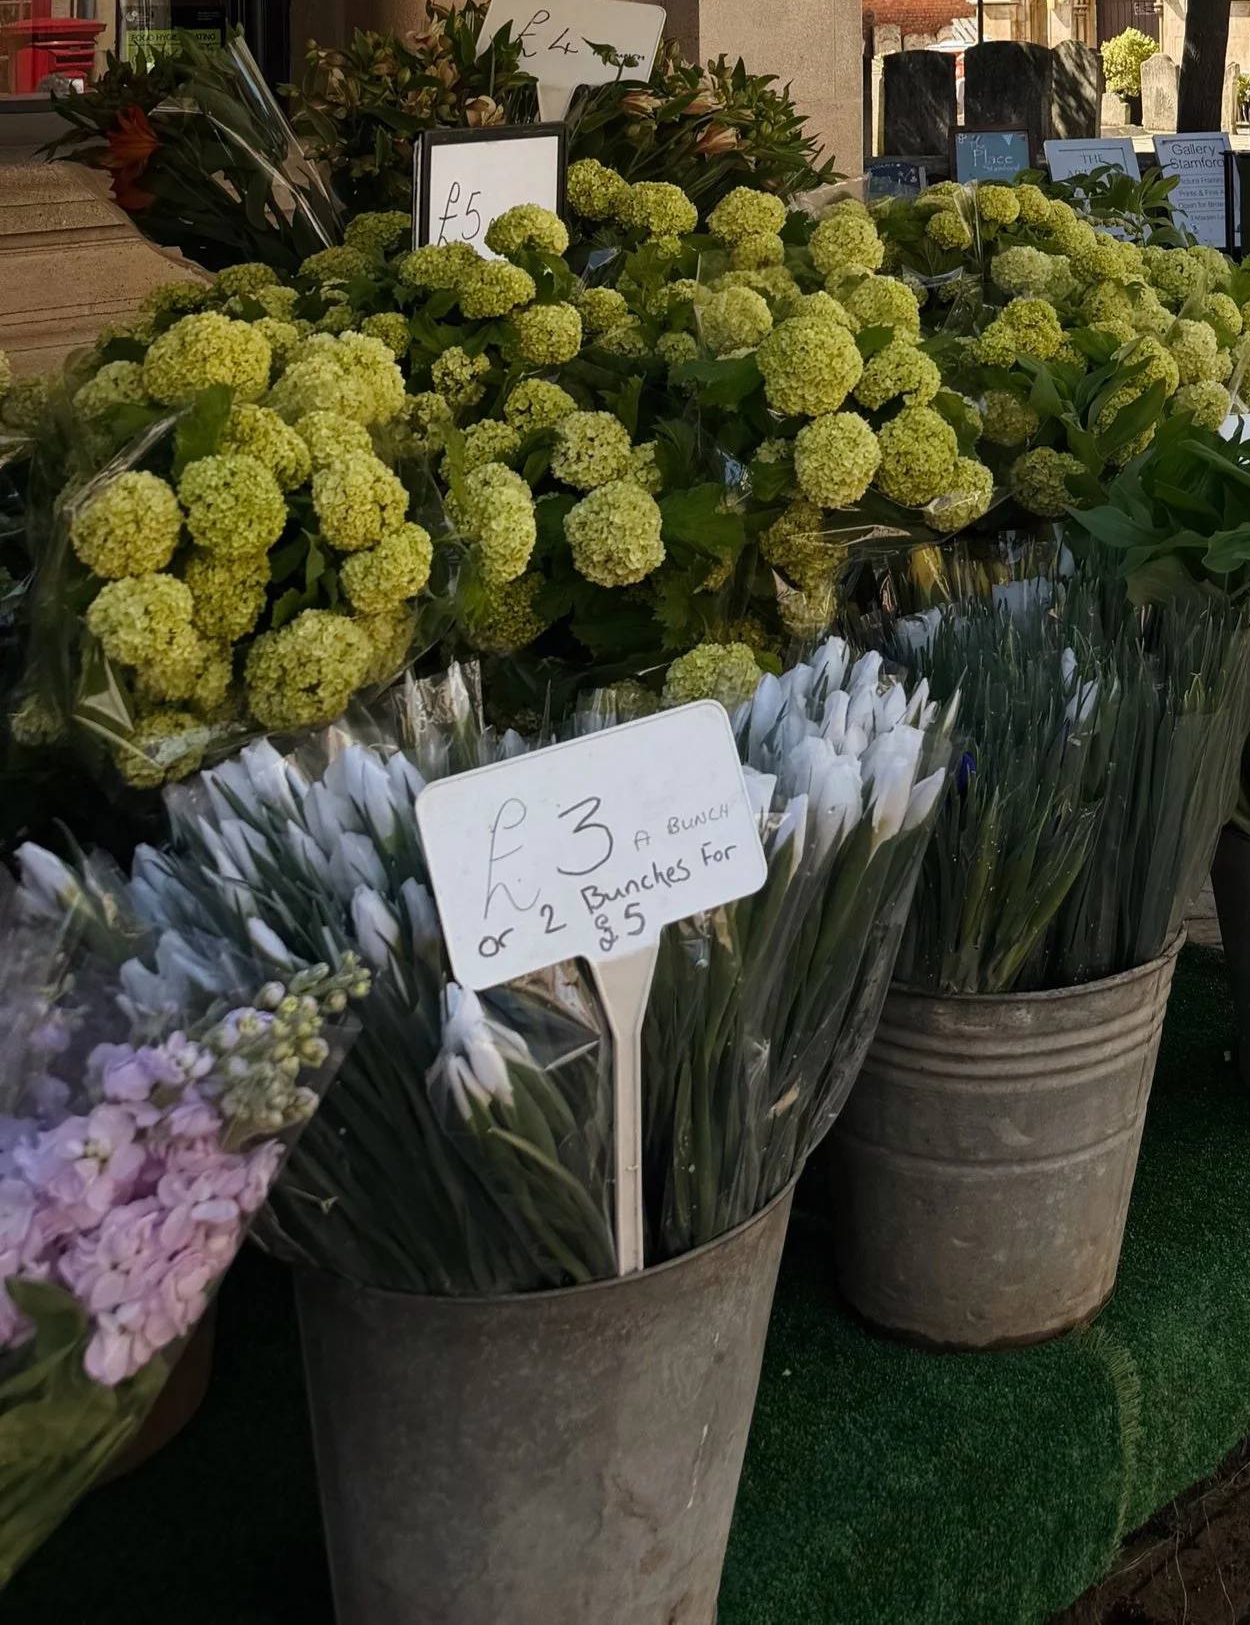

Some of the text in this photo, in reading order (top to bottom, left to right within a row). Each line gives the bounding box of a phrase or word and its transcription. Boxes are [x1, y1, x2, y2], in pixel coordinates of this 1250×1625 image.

[130, 33, 217, 42] FOOD HYGIE ATING
[972, 148, 1013, 168] Place
[1171, 143, 1216, 157] Gallery
[633, 829, 653, 852] A
[666, 803, 732, 836] BUNCH
[478, 926, 514, 958] or
[538, 903, 569, 935] 2
[579, 858, 693, 917] Bunches
